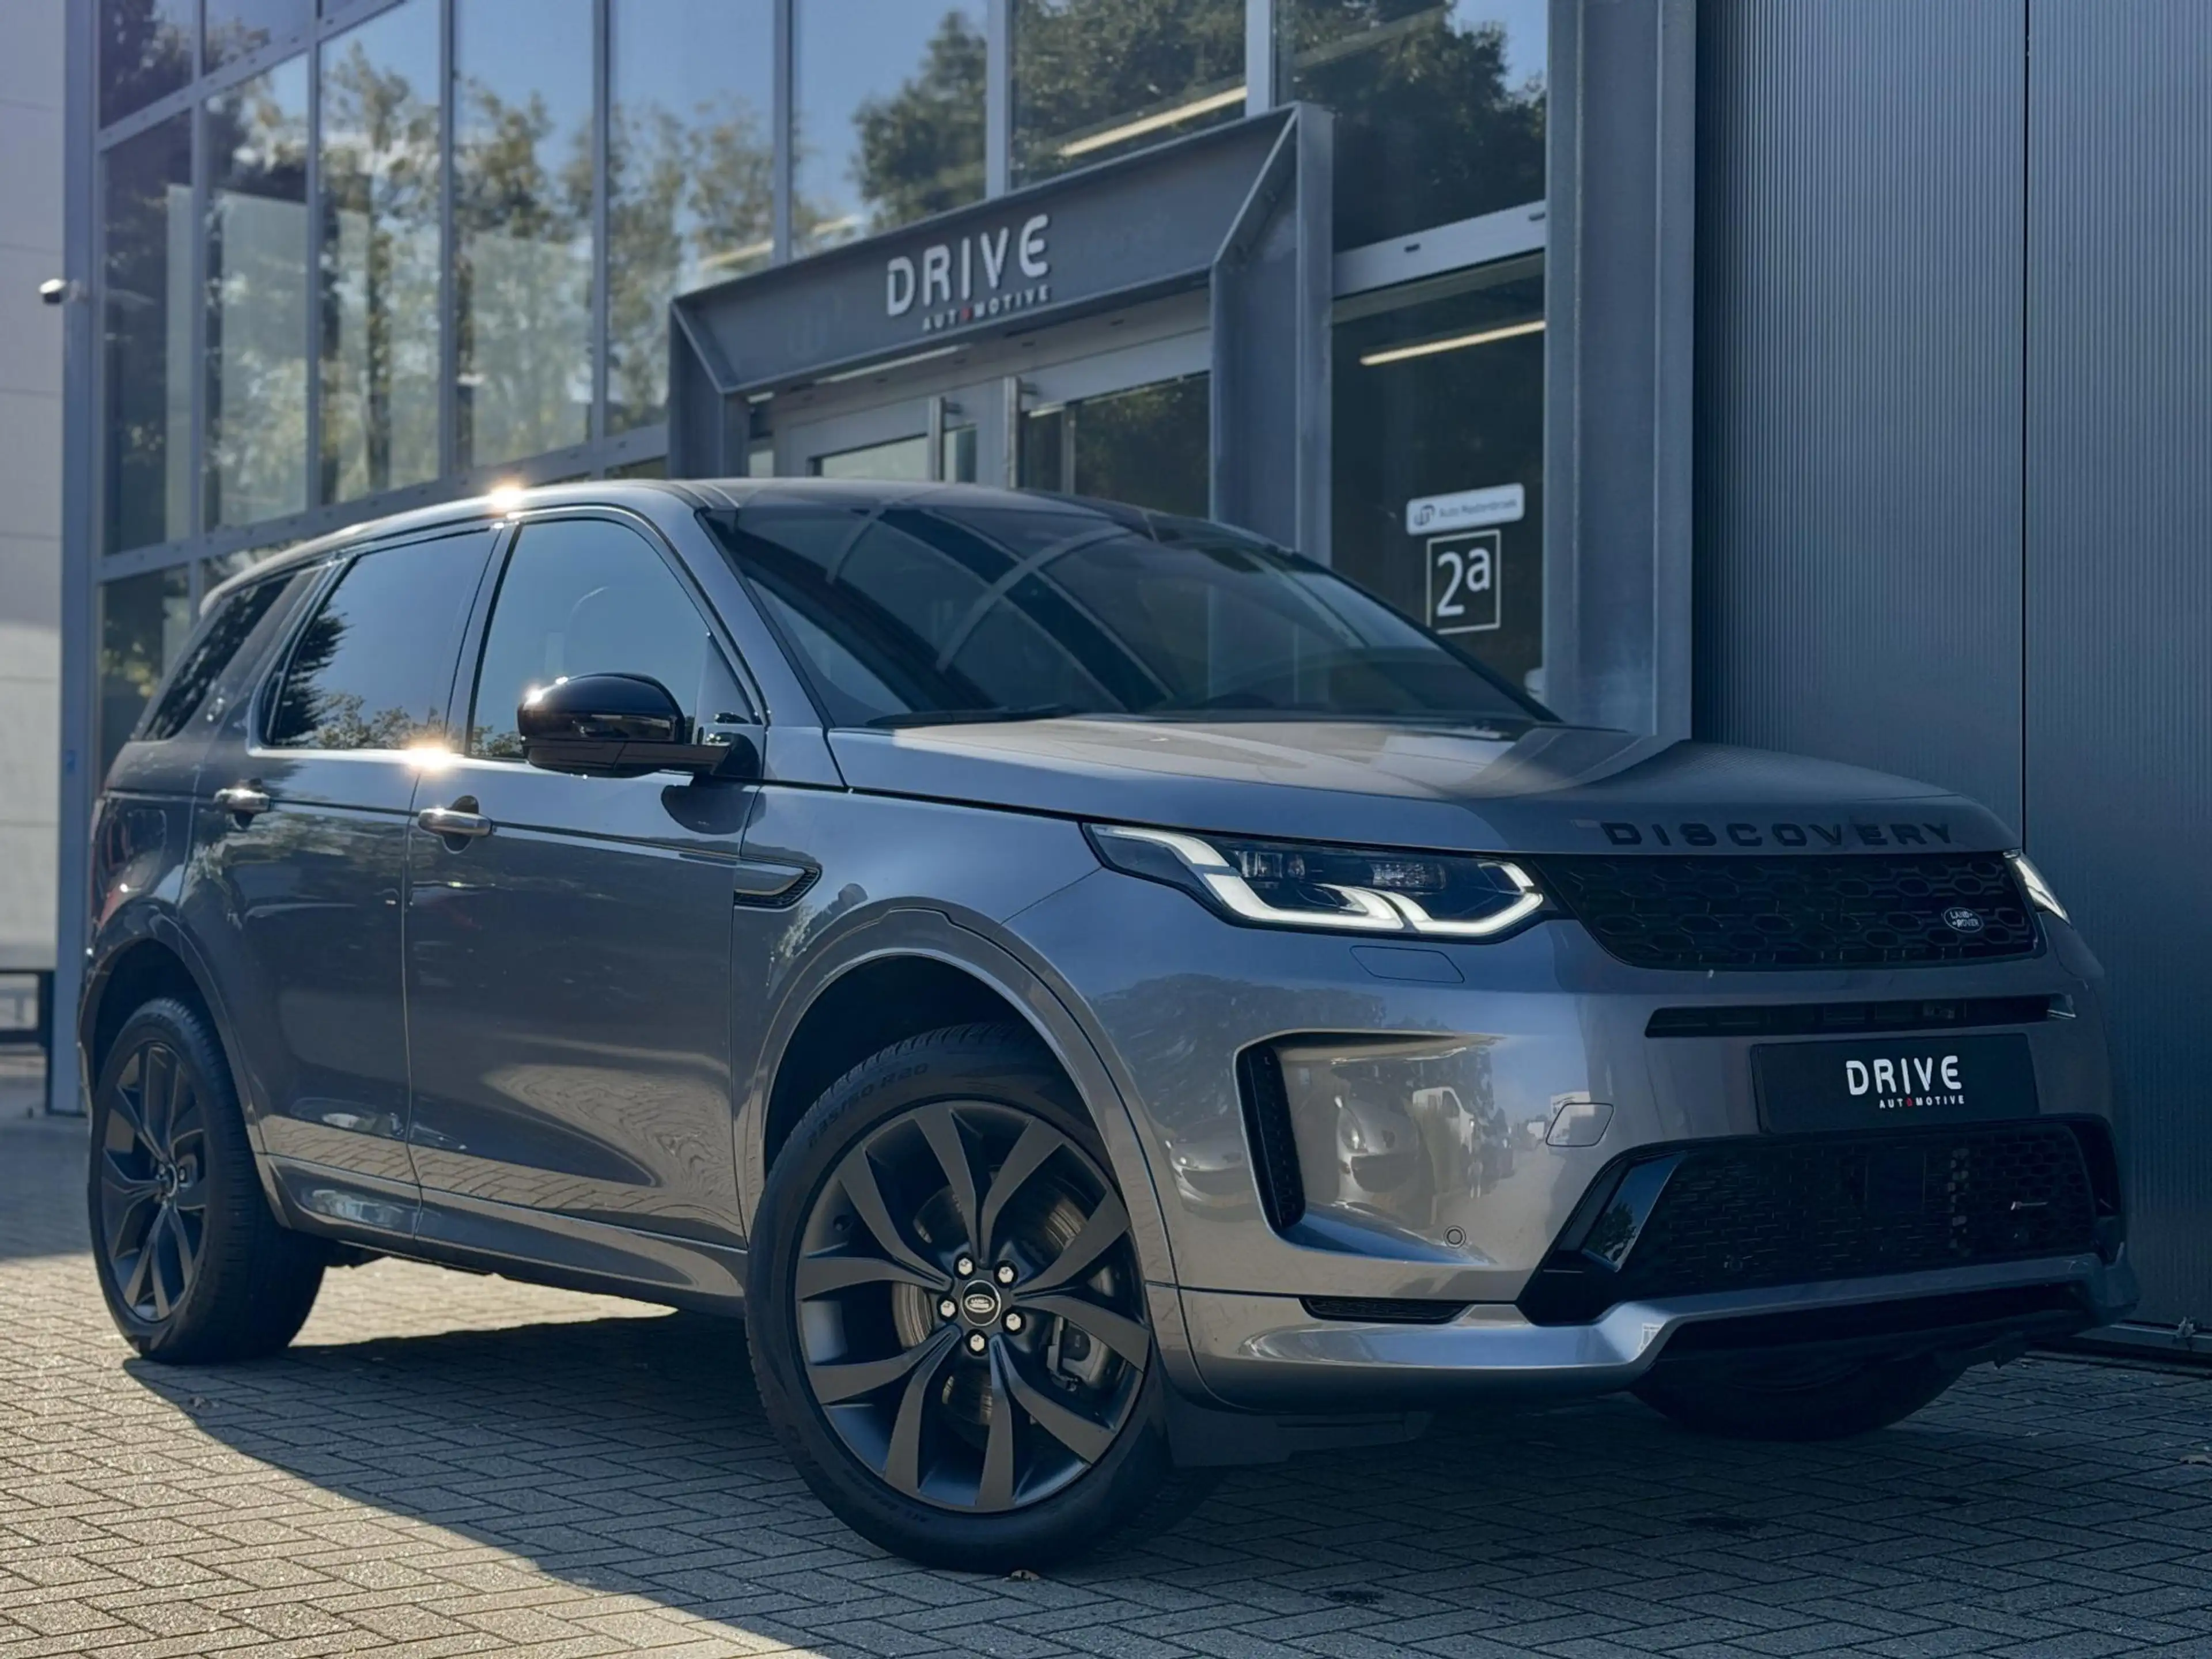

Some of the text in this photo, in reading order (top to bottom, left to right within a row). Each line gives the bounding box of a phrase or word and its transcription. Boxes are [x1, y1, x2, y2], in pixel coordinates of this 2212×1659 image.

[887, 214, 1048, 316] DRIVE
[923, 284, 1048, 331] AUTOMOTIVE
[1437, 547, 1491, 616] 2a
[1600, 822, 1952, 846] DISCOVERY
[1846, 1055, 1962, 1096] DRIVE
[1879, 1095, 1965, 1109] AUTOMOTIVE
